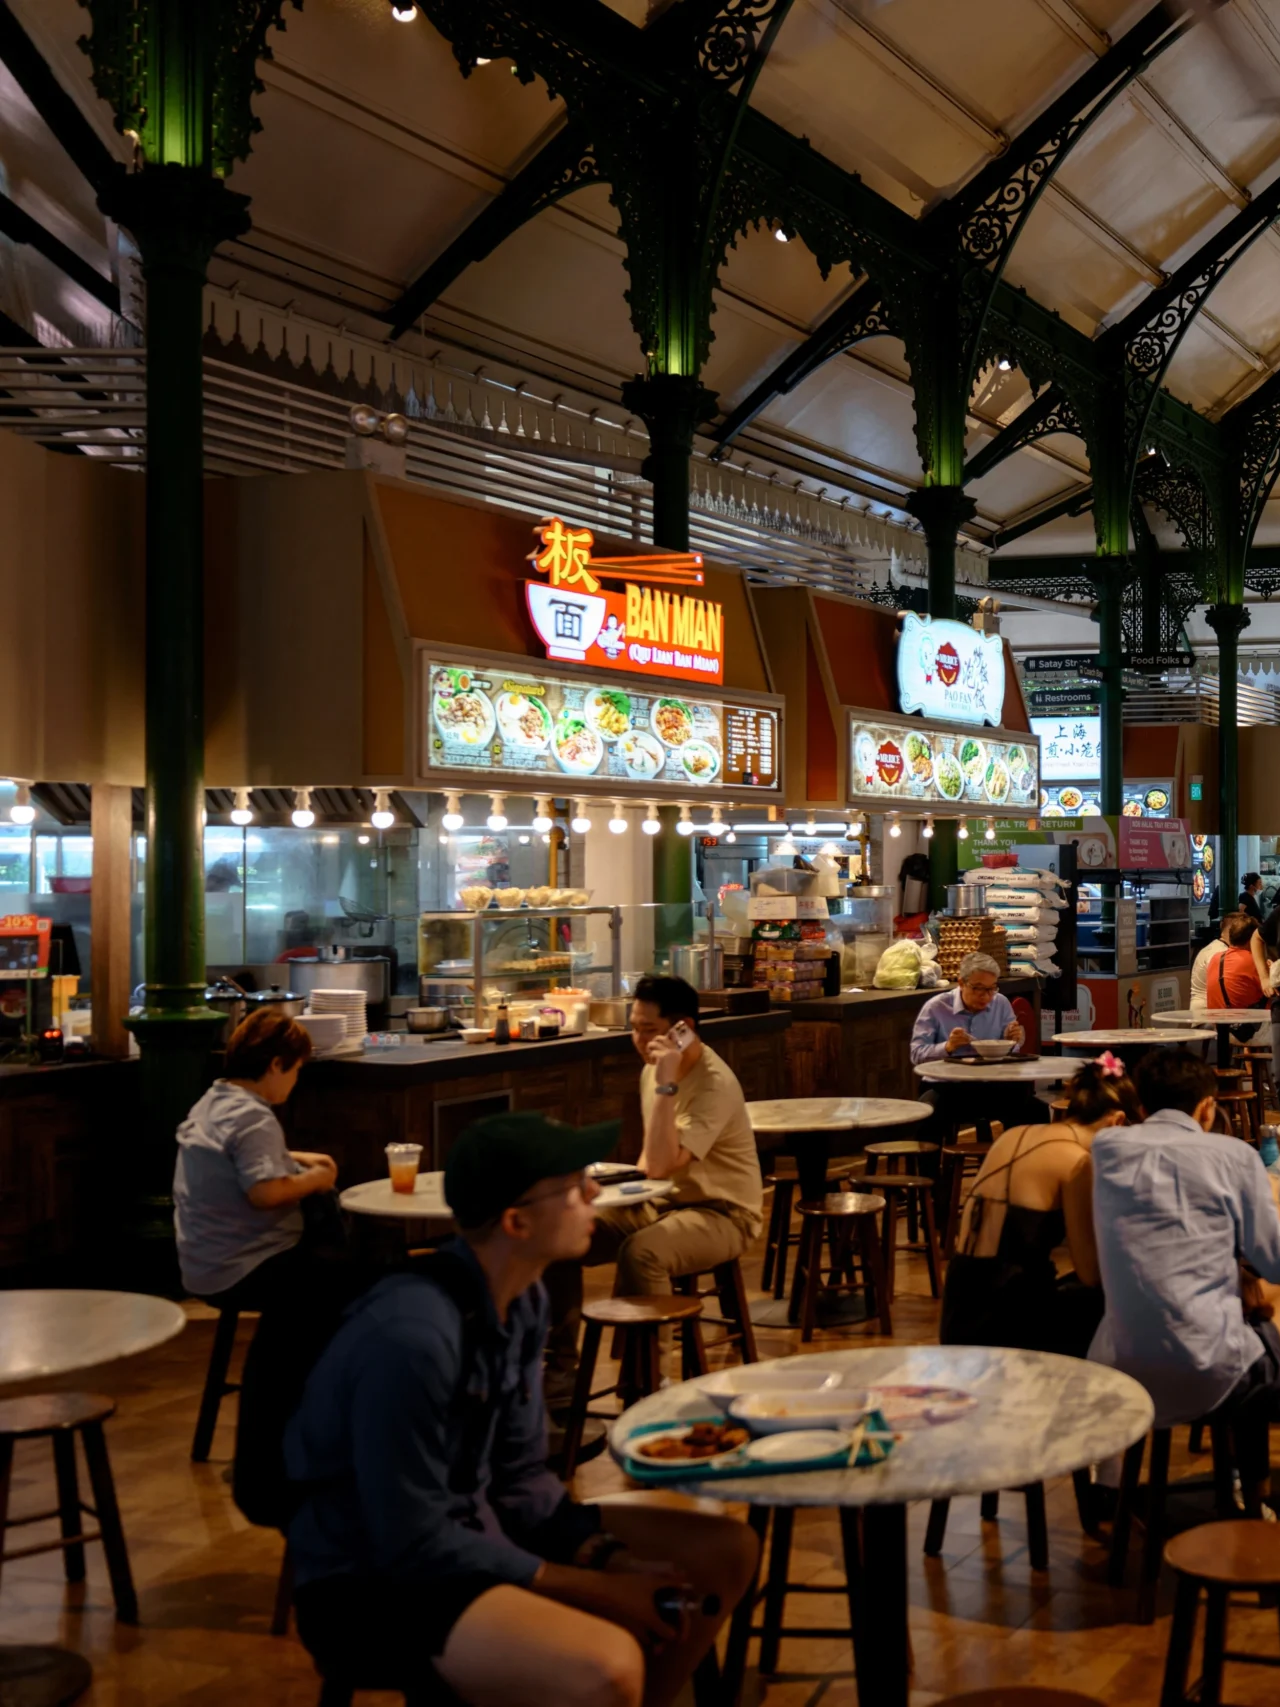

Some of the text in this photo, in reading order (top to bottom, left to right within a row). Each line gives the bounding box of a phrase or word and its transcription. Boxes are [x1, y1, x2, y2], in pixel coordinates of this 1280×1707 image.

[538, 521, 600, 594] 板
[548, 598, 588, 642] 面
[625, 582, 722, 652] BAN MIAN
[1039, 660, 1063, 668] Satay
[1131, 655, 1180, 664] Food Folks
[1045, 693, 1091, 702] Restrooms
[1054, 722, 1087, 740] 上海
[982, 820, 1010, 828] HLAL
[1040, 820, 1076, 828] RETURN
